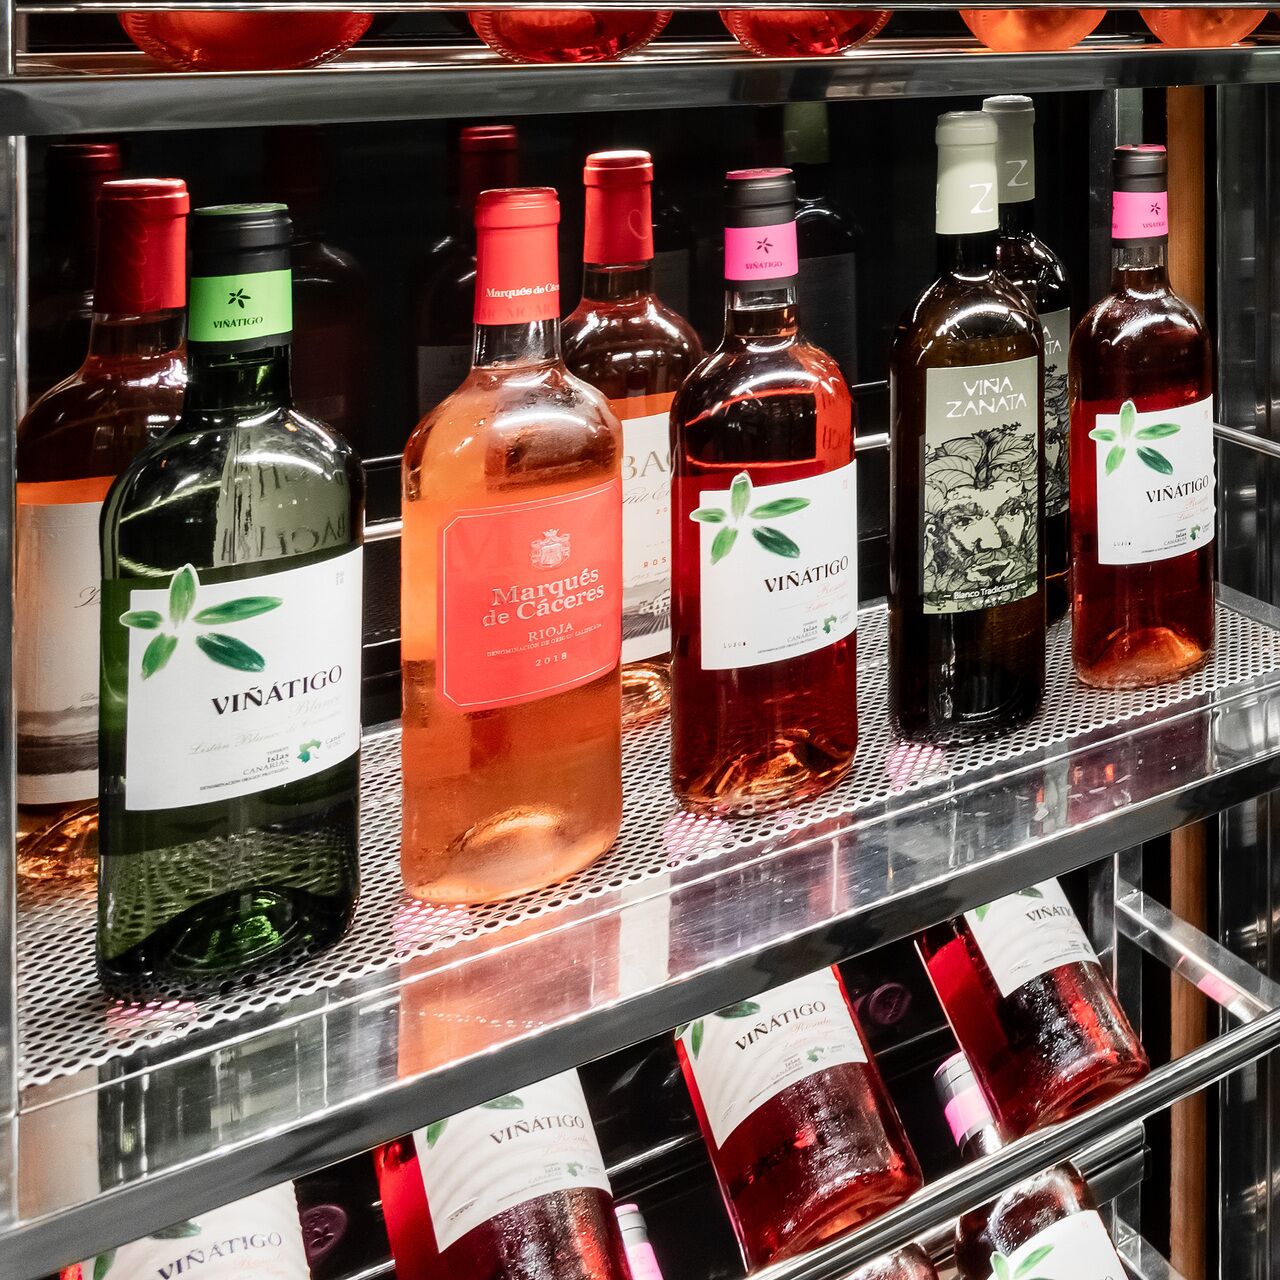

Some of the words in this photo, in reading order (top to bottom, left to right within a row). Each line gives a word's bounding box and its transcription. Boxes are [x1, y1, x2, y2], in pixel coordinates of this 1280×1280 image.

[969, 181, 995, 214] Z
[485, 285, 532, 299] Marqués
[533, 285, 545, 295] de
[962, 375, 1014, 397] VIÑA
[945, 392, 1028, 419] ZANATA
[1145, 474, 1209, 503] VIÑÁTIGO
[491, 567, 601, 607] Marqués
[764, 554, 849, 594] VIÑÁTIGO
[954, 587, 980, 601] Blanco
[981, 581, 1019, 597] Tradicional
[481, 609, 510, 628] de
[515, 583, 606, 621] Cáceres
[526, 621, 575, 643] RIOJA
[535, 651, 568, 667] 2018
[210, 663, 343, 716] VIÑÁTIGO
[242, 759, 290, 776] CANARIAS
[267, 753, 290, 764] Islas
[735, 999, 827, 1052] VIÑÁTIGO
[490, 1113, 586, 1145] VIÑÁTIGO
